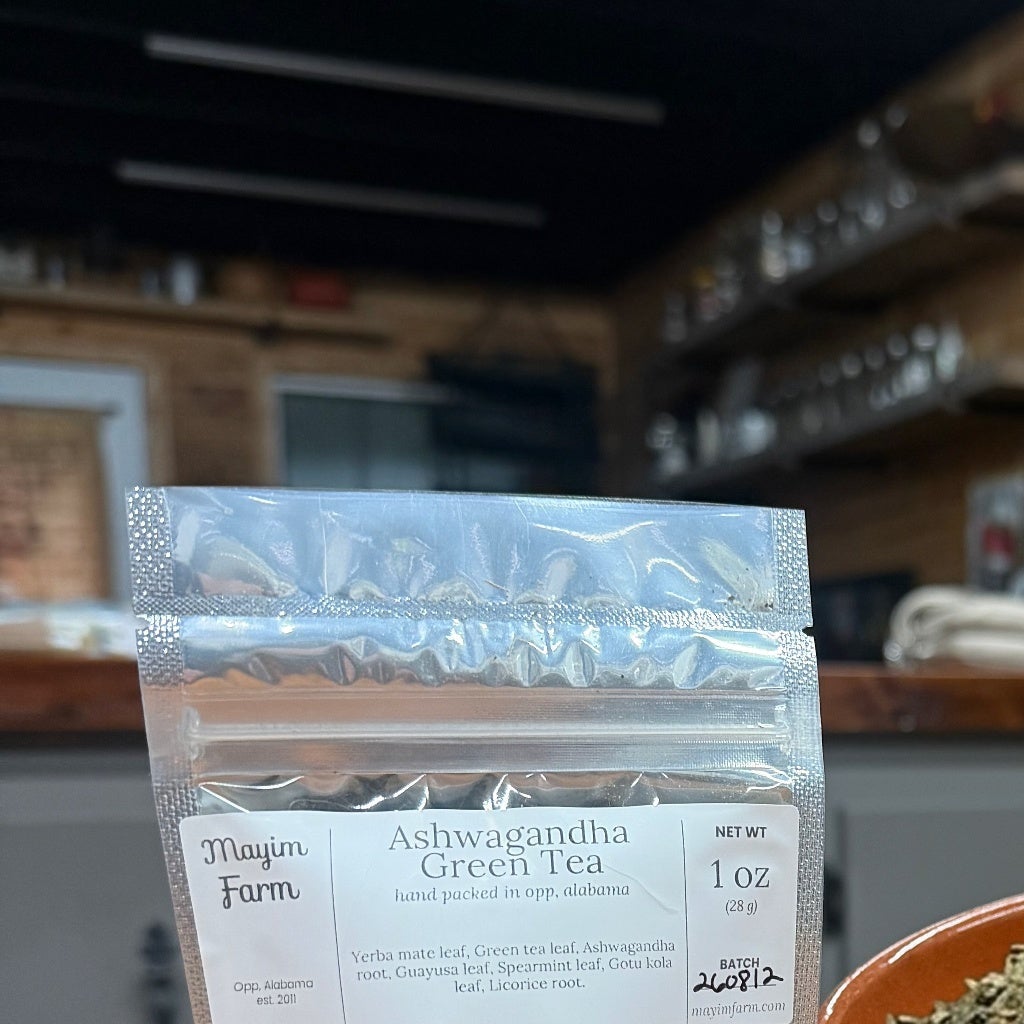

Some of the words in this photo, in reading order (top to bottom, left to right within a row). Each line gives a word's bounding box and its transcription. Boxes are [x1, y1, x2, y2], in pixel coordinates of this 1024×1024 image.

[388, 819, 630, 856] Ashwagandha
[715, 825, 742, 838] NET
[746, 825, 767, 838] WT
[201, 836, 309, 870] Mayim
[421, 852, 530, 878] Green
[540, 849, 604, 875] Tea
[710, 859, 724, 889] 1
[734, 866, 770, 889] oz
[218, 874, 301, 909] Farm
[395, 888, 438, 902] hand
[442, 886, 498, 904] packed
[504, 885, 521, 899] in
[525, 886, 560, 902] opp,
[563, 882, 630, 897] alabama
[725, 899, 744, 915] (28
[747, 899, 758, 916] g)
[352, 949, 394, 964] Yerba
[398, 948, 436, 961] mate
[439, 945, 471, 960] leaf,
[474, 944, 519, 957] Green
[524, 944, 546, 955] tea
[550, 941, 579, 955] leaf,
[583, 939, 676, 955] Ashwagandha
[357, 968, 392, 981] root,
[396, 965, 459, 980] Guayusa
[463, 962, 494, 976] leaf,
[498, 959, 572, 977] Spearmint
[576, 958, 605, 972] leaf,
[608, 957, 642, 970] Gotu
[646, 957, 673, 969] kola
[719, 957, 760, 970] BATCH
[234, 981, 262, 993] Opp,
[264, 979, 314, 990] Alabama
[454, 980, 485, 994] leaf,
[489, 978, 548, 991] Licorice
[552, 978, 586, 989] root.
[693, 966, 784, 993] 260812
[256, 995, 273, 1006] est.
[277, 993, 297, 1005] 2011
[691, 1001, 786, 1020] mayimfarm.com
